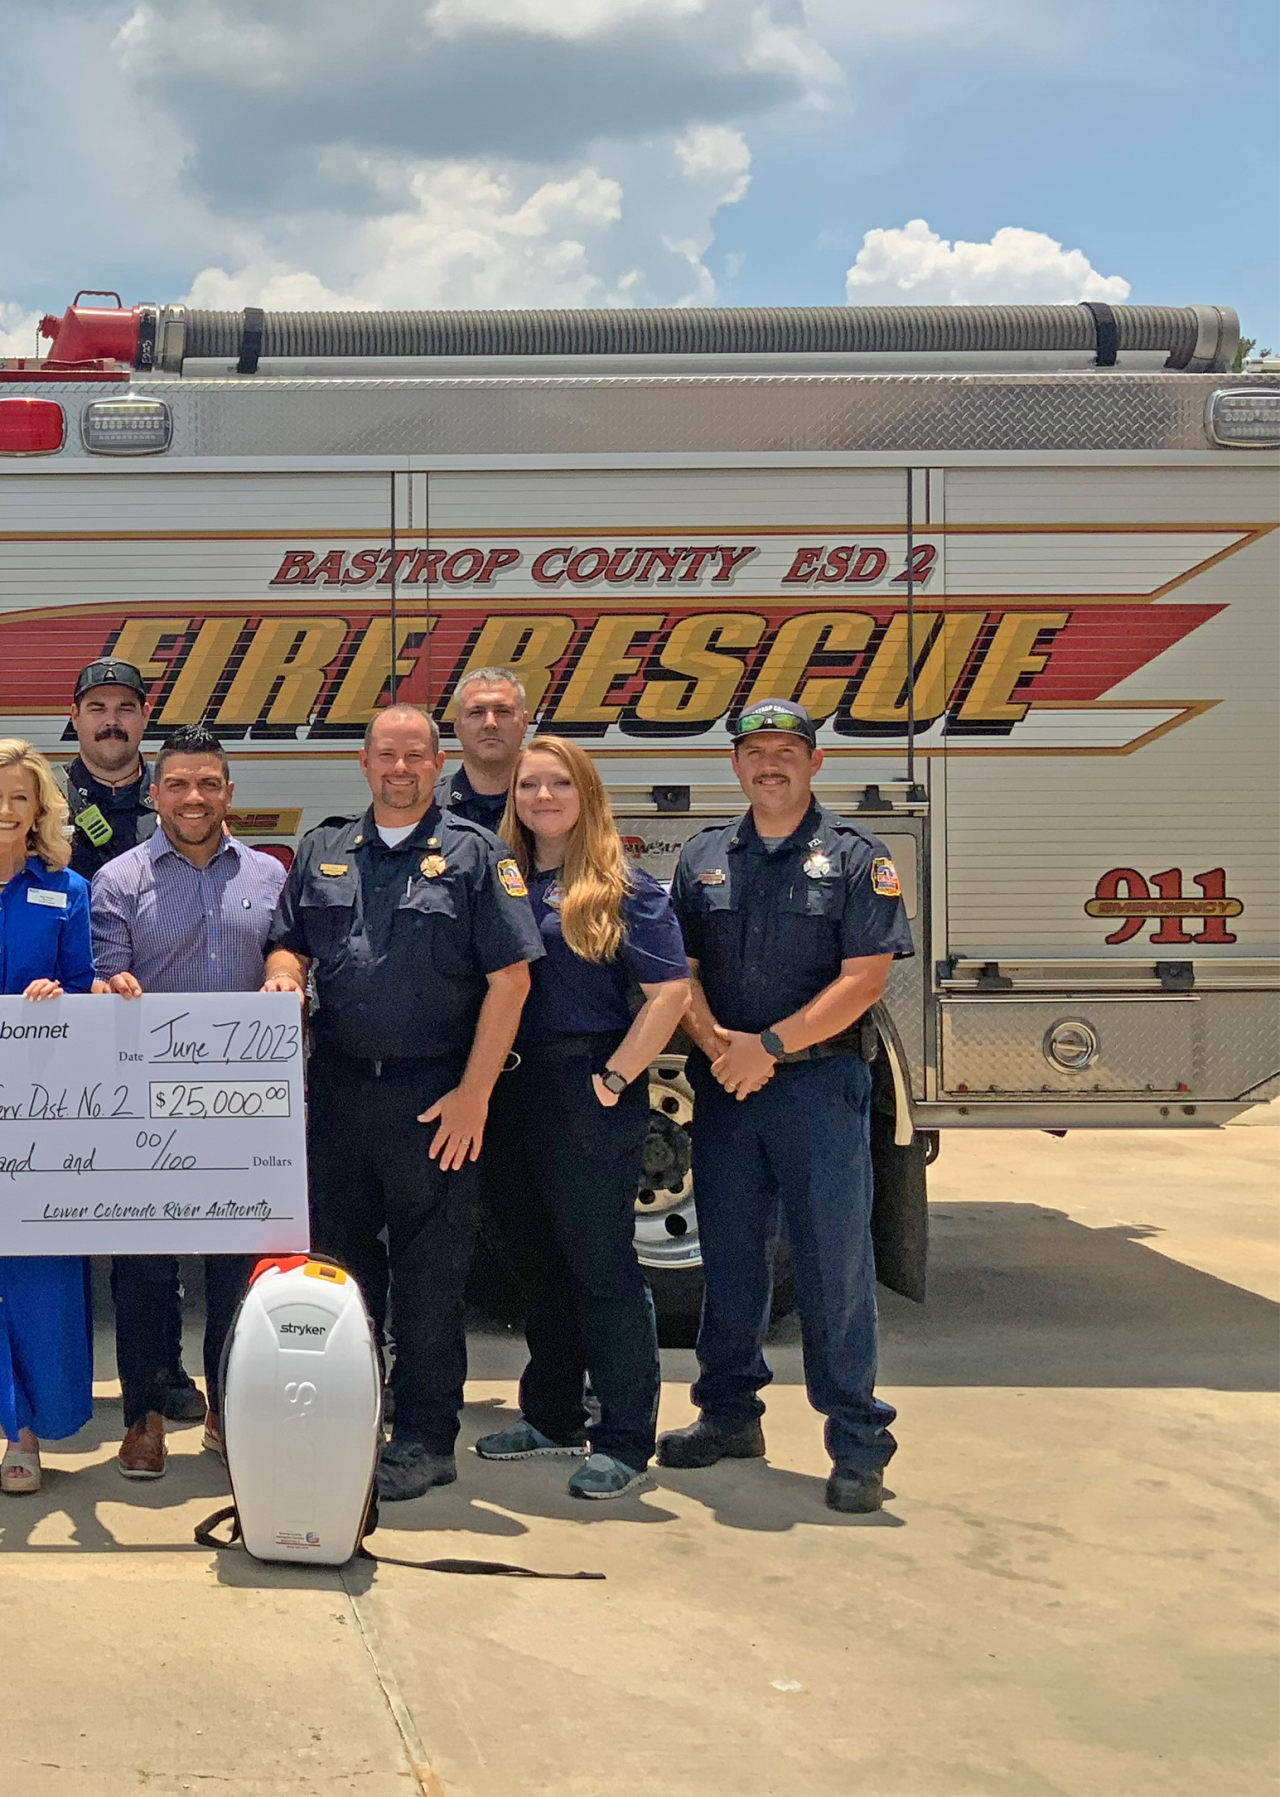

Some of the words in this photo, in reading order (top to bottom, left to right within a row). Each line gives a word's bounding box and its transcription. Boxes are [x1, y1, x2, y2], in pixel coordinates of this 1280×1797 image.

[268, 547, 521, 585] BASTROP
[530, 546, 758, 584] COUNTY
[780, 544, 888, 584] ESD
[889, 544, 937, 583] 2
[82, 615, 442, 739] FIRE
[442, 611, 1073, 736] RESCUE
[225, 814, 280, 829] NE
[1095, 867, 1238, 945] 911
[1098, 901, 1233, 914] EMERGENCY
[150, 1012, 209, 1064] June
[240, 1020, 299, 1060] 2023
[119, 1052, 144, 1062] Date
[28, 1083, 70, 1120] Dist.
[77, 1083, 105, 1118] No.
[110, 1085, 134, 1116] 2
[63, 1147, 97, 1175] and
[253, 1156, 293, 1167] Dollars
[43, 1203, 88, 1219] Lower
[93, 1202, 157, 1218] Colorado
[162, 1201, 200, 1220] River
[205, 1199, 272, 1221] Authority
[279, 1322, 326, 1336] stryker
